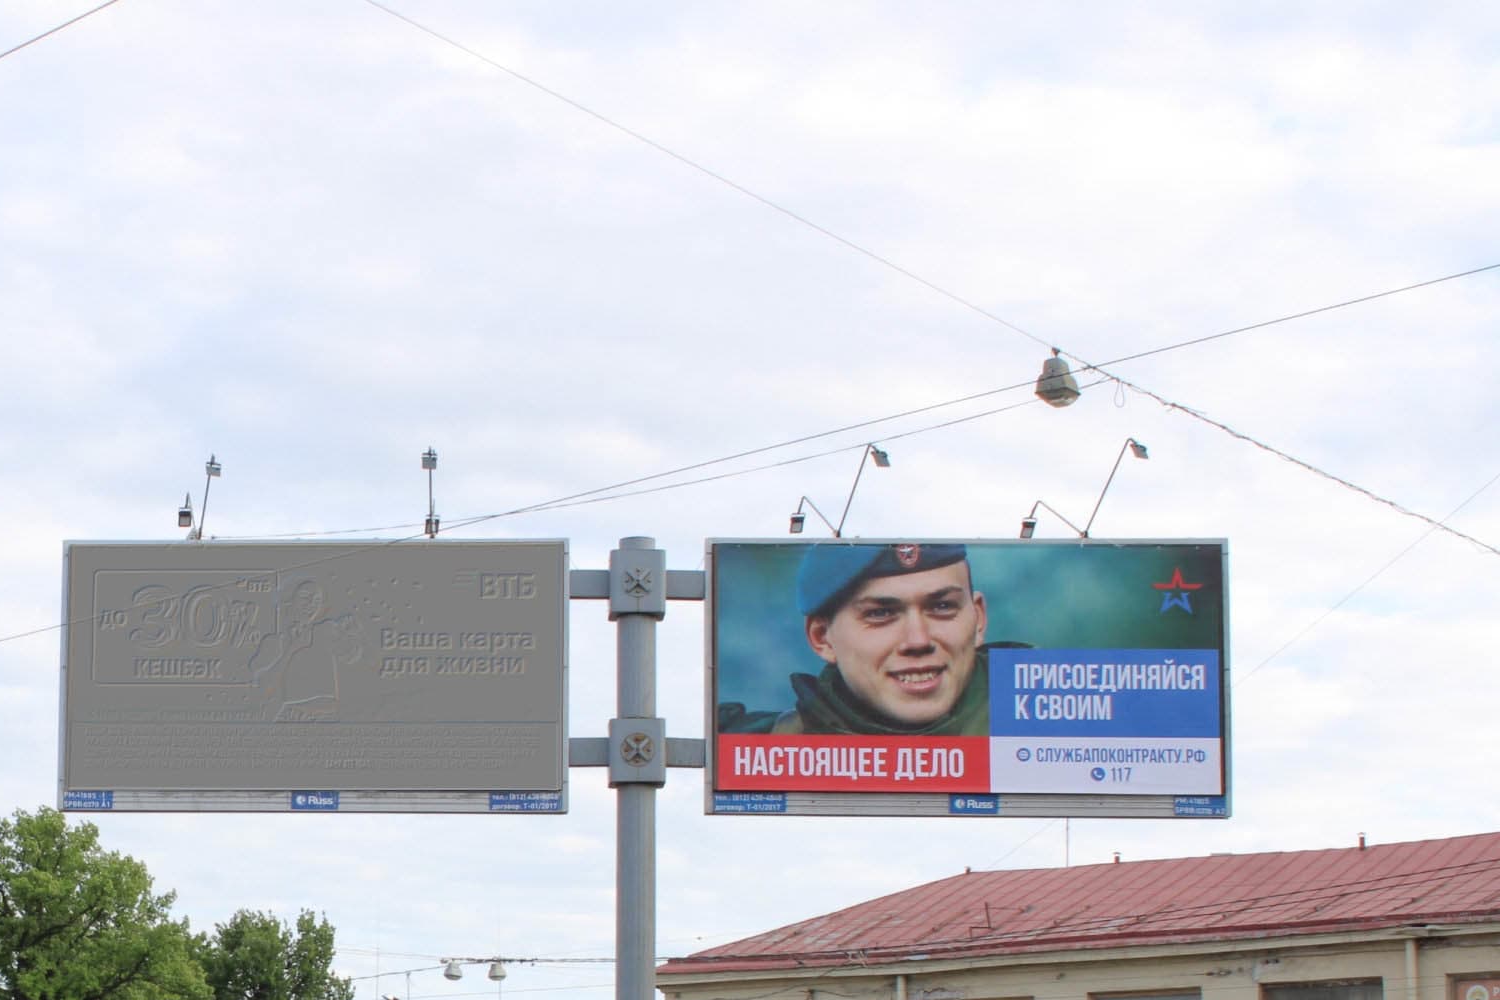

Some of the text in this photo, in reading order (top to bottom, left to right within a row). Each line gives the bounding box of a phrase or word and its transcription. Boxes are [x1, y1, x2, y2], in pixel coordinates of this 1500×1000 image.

[479, 572, 537, 600] ВТБ
[380, 628, 537, 655] Ваша карта
[380, 656, 525, 679] для жизни
[1014, 659, 1205, 692] ПРИСОЕДИНЯЙСЯ
[1015, 694, 1112, 721] К СВОИМ
[734, 746, 965, 780] НАСТОЯЩЕЕ ДЕЛО
[1036, 748, 1205, 764] СЛУЖБАПОКОНТРАКТУ.РФ
[1111, 768, 1132, 781] 117
[308, 796, 334, 805] Russ
[967, 800, 993, 808] Russ
